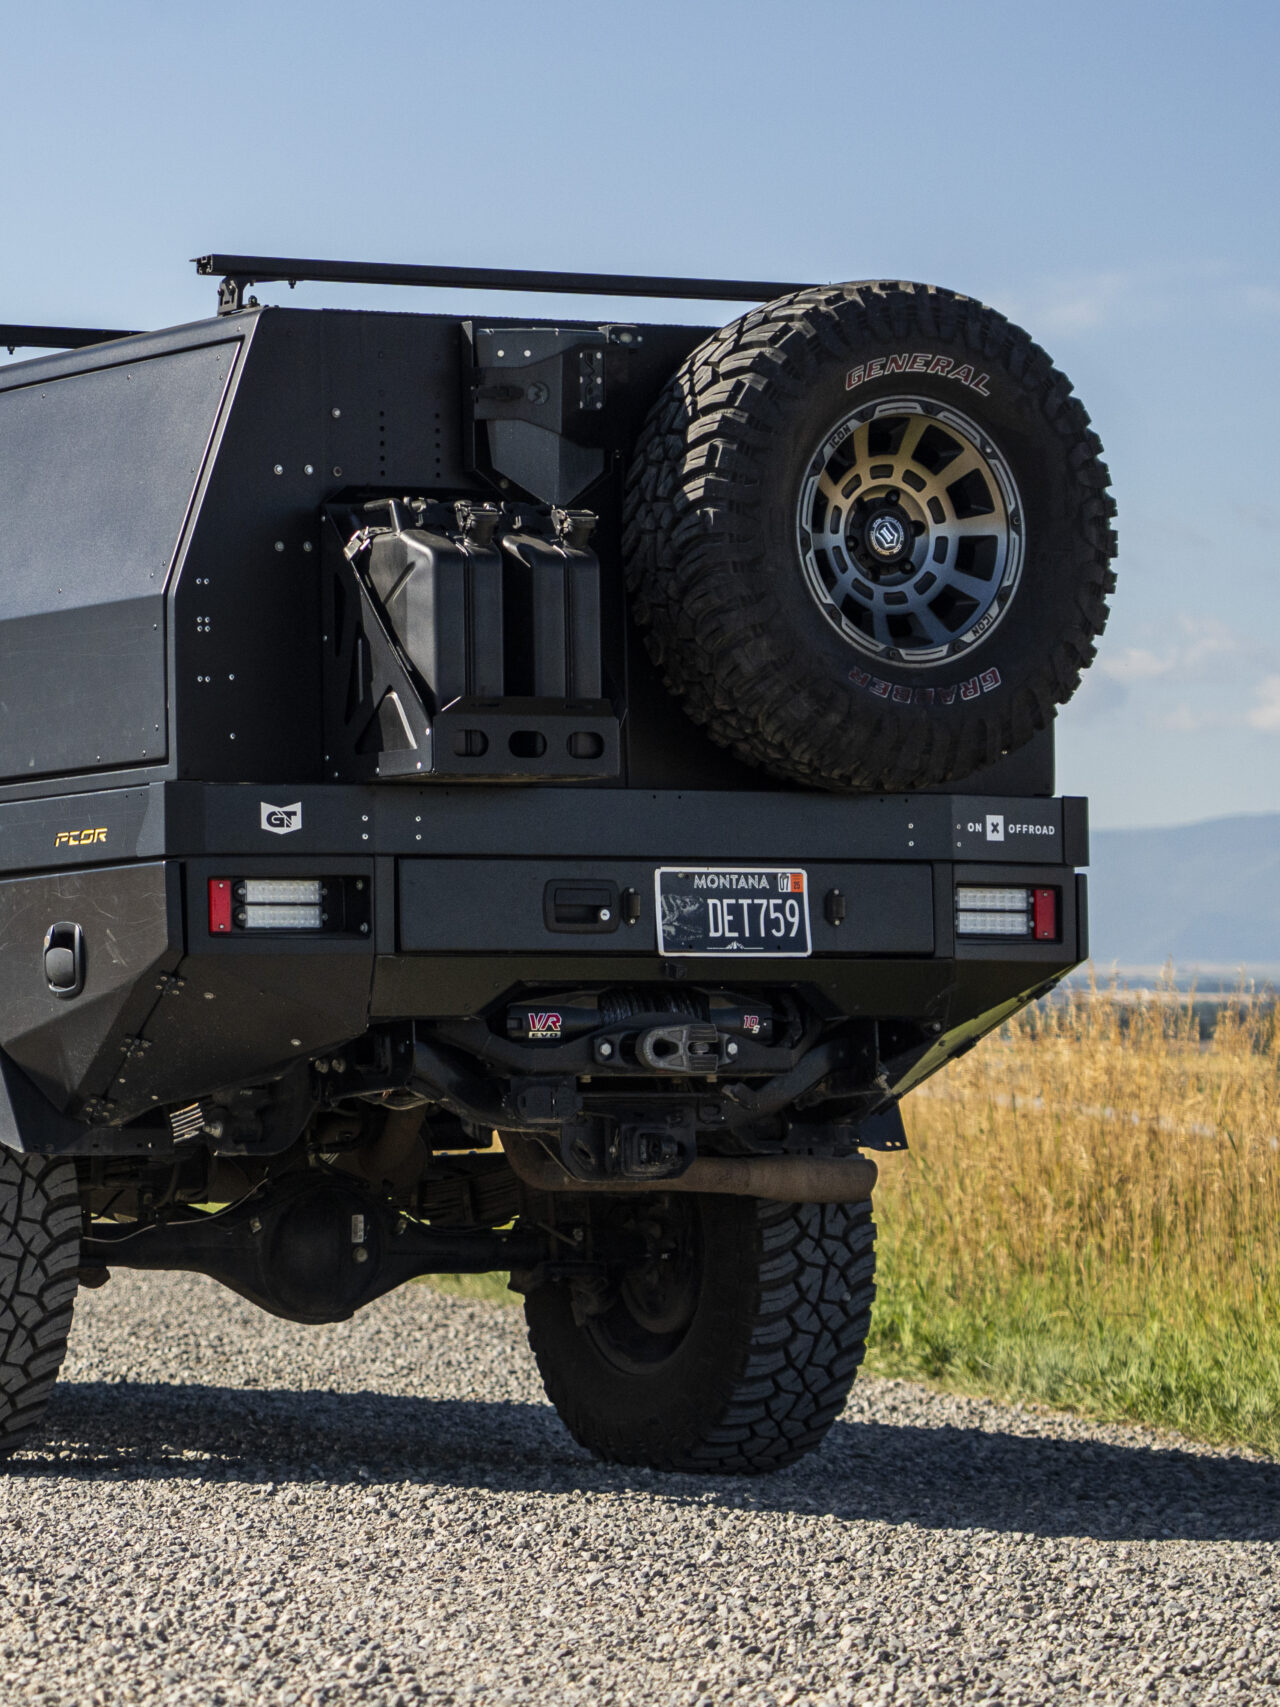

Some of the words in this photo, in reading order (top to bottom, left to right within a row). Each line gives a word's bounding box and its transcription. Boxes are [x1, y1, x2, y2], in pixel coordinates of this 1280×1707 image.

[845, 353, 991, 397] GENERAL
[829, 424, 851, 449] ICON
[971, 612, 993, 637] ICON
[967, 822, 982, 832] ON
[1008, 824, 1055, 835] OFFROAD
[693, 874, 770, 889] MONTANA
[706, 898, 801, 937] DET759
[528, 1013, 562, 1031] VR
